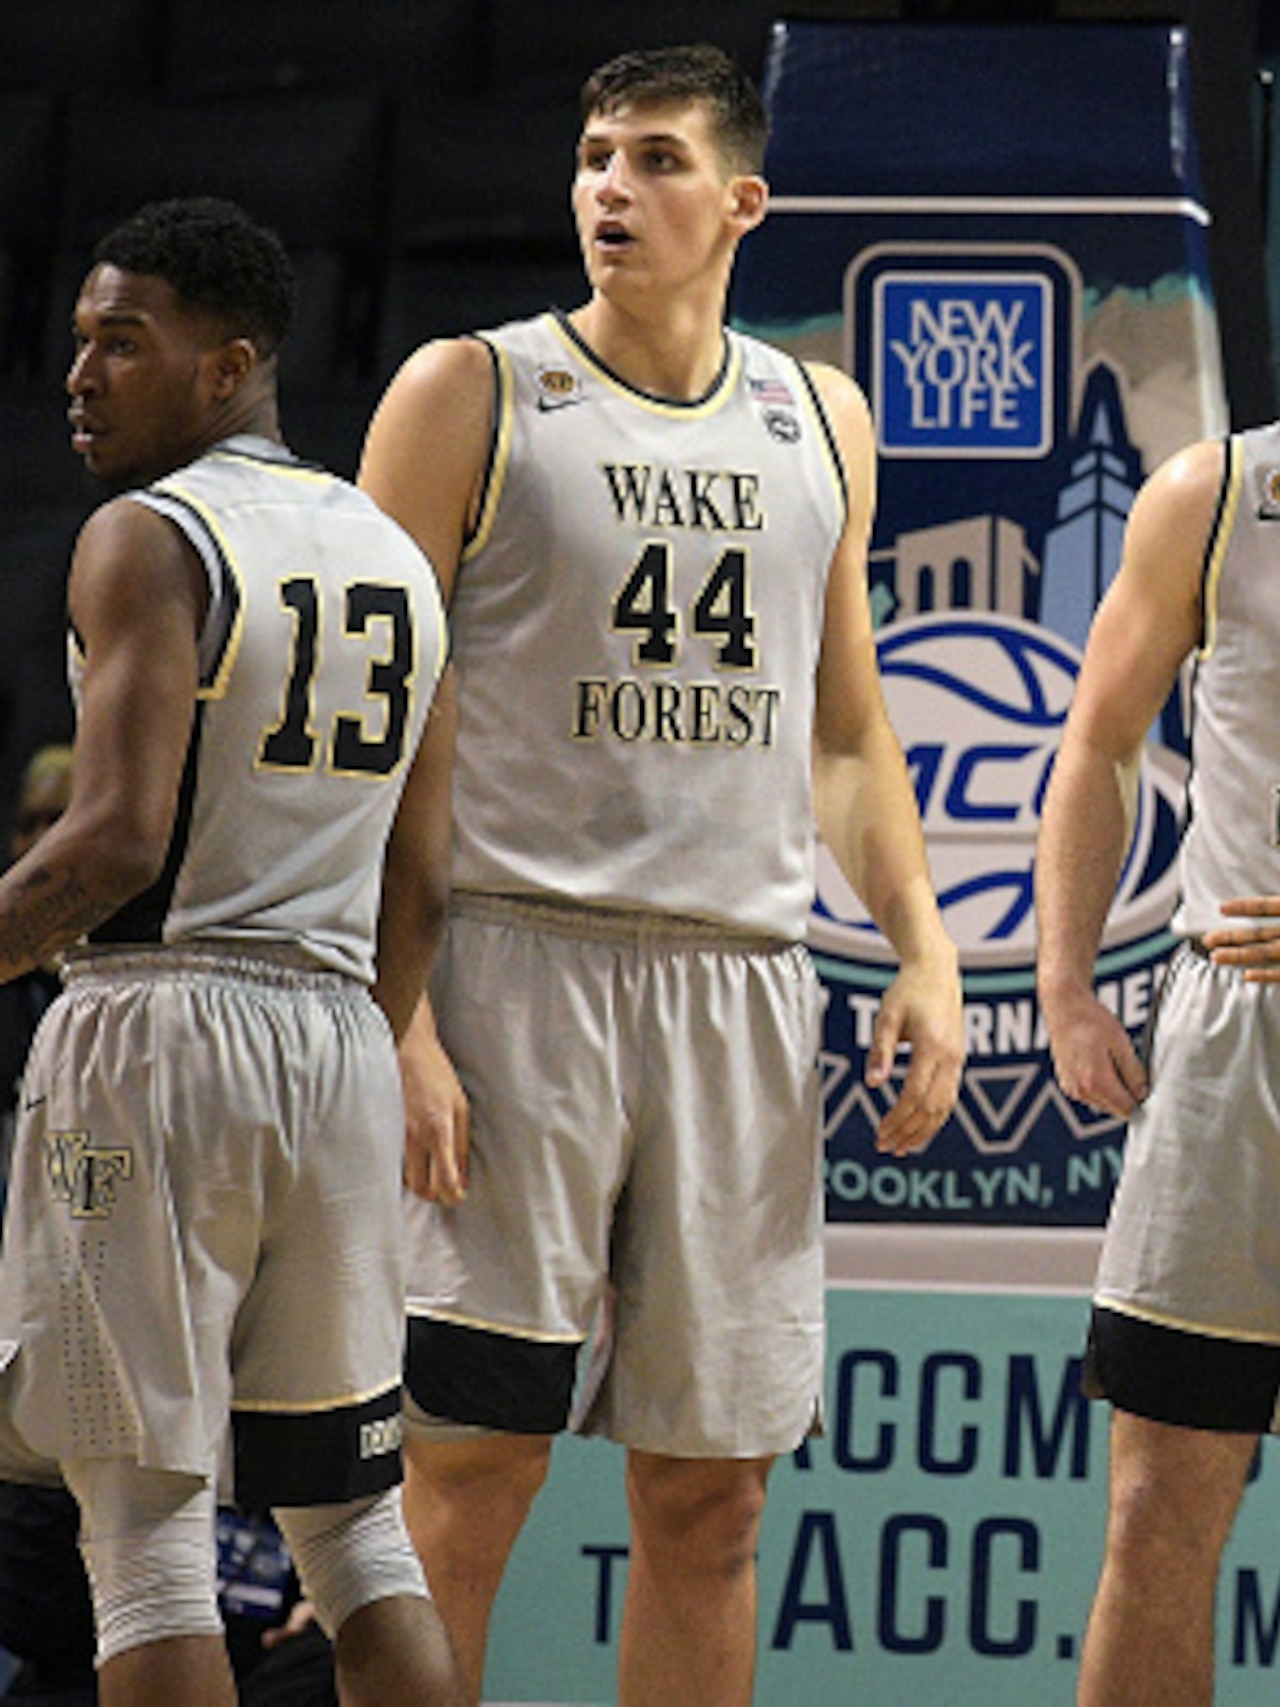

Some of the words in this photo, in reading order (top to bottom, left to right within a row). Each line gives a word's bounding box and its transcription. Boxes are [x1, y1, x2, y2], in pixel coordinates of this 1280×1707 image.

[911, 300, 1023, 344] NEW
[890, 340, 1034, 389] YORK
[912, 384, 1019, 429] LIFE
[602, 465, 763, 531] WAKE
[612, 541, 757, 670] 44
[255, 577, 417, 778] 13
[573, 681, 779, 748] FOREST
